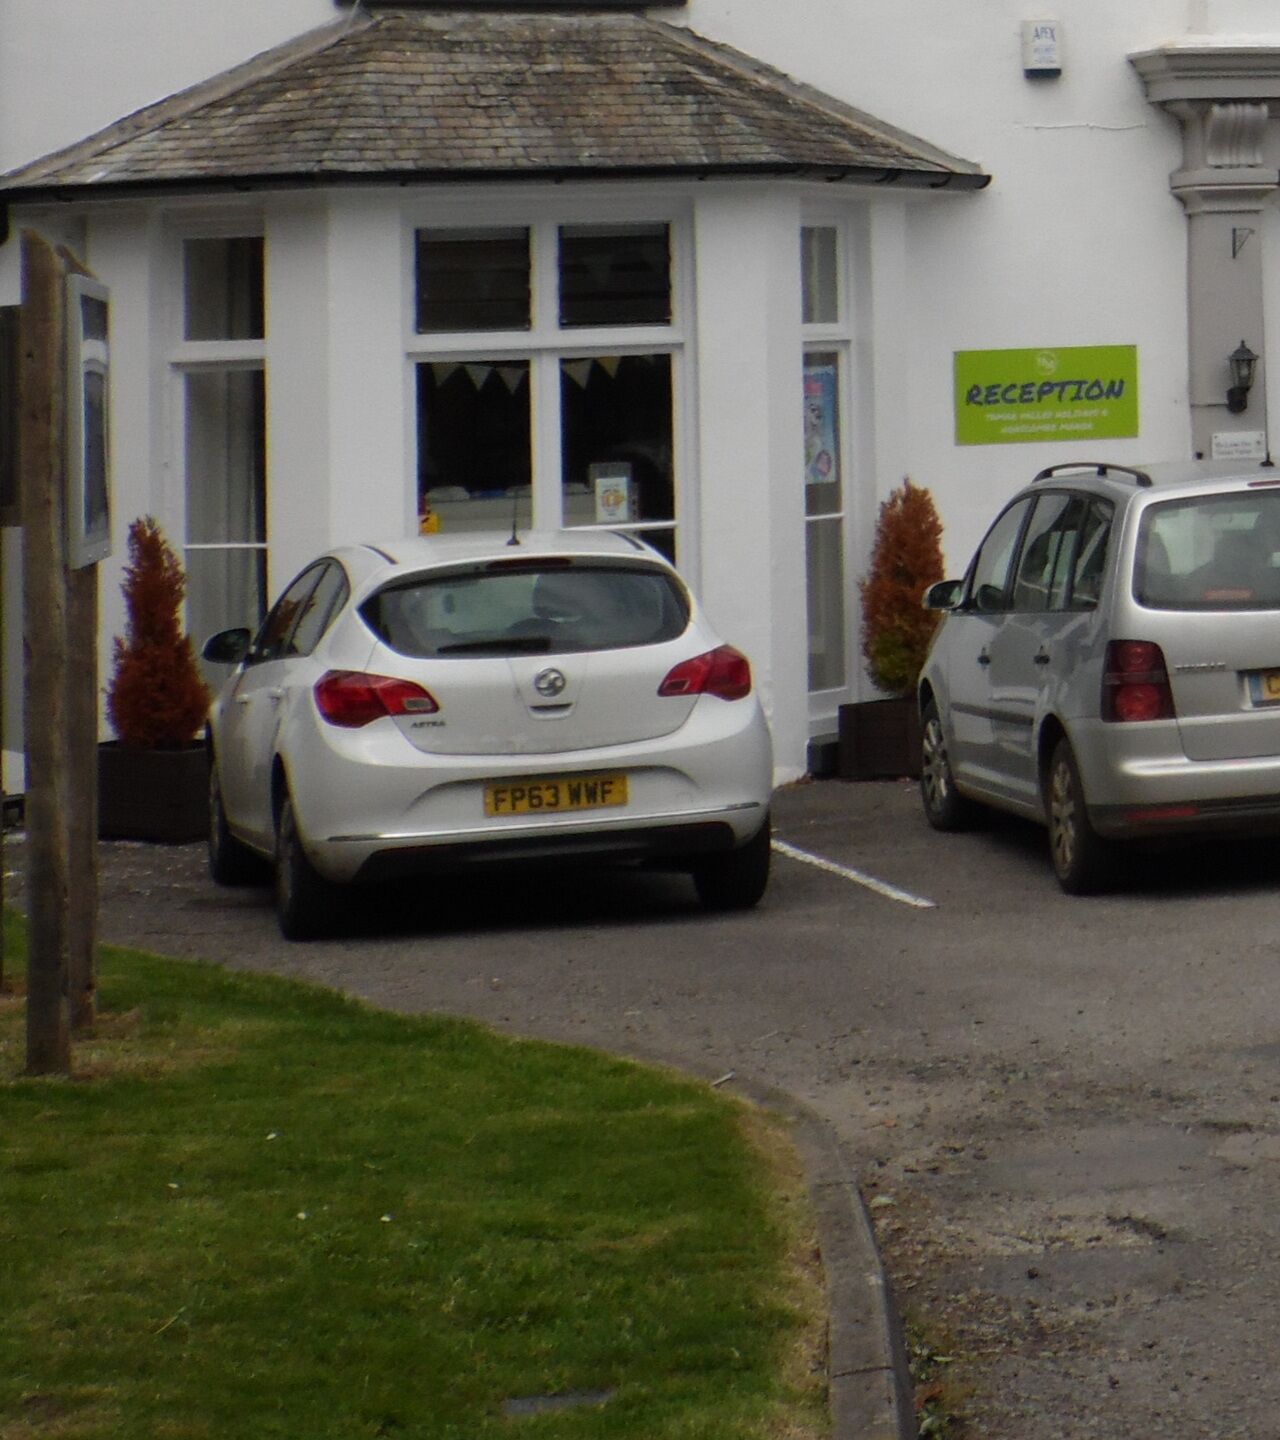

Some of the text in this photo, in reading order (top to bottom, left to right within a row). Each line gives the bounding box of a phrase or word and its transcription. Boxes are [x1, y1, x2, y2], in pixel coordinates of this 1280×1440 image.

[966, 378, 1126, 406] RECEPTION
[493, 780, 614, 811] FP63 WWF
